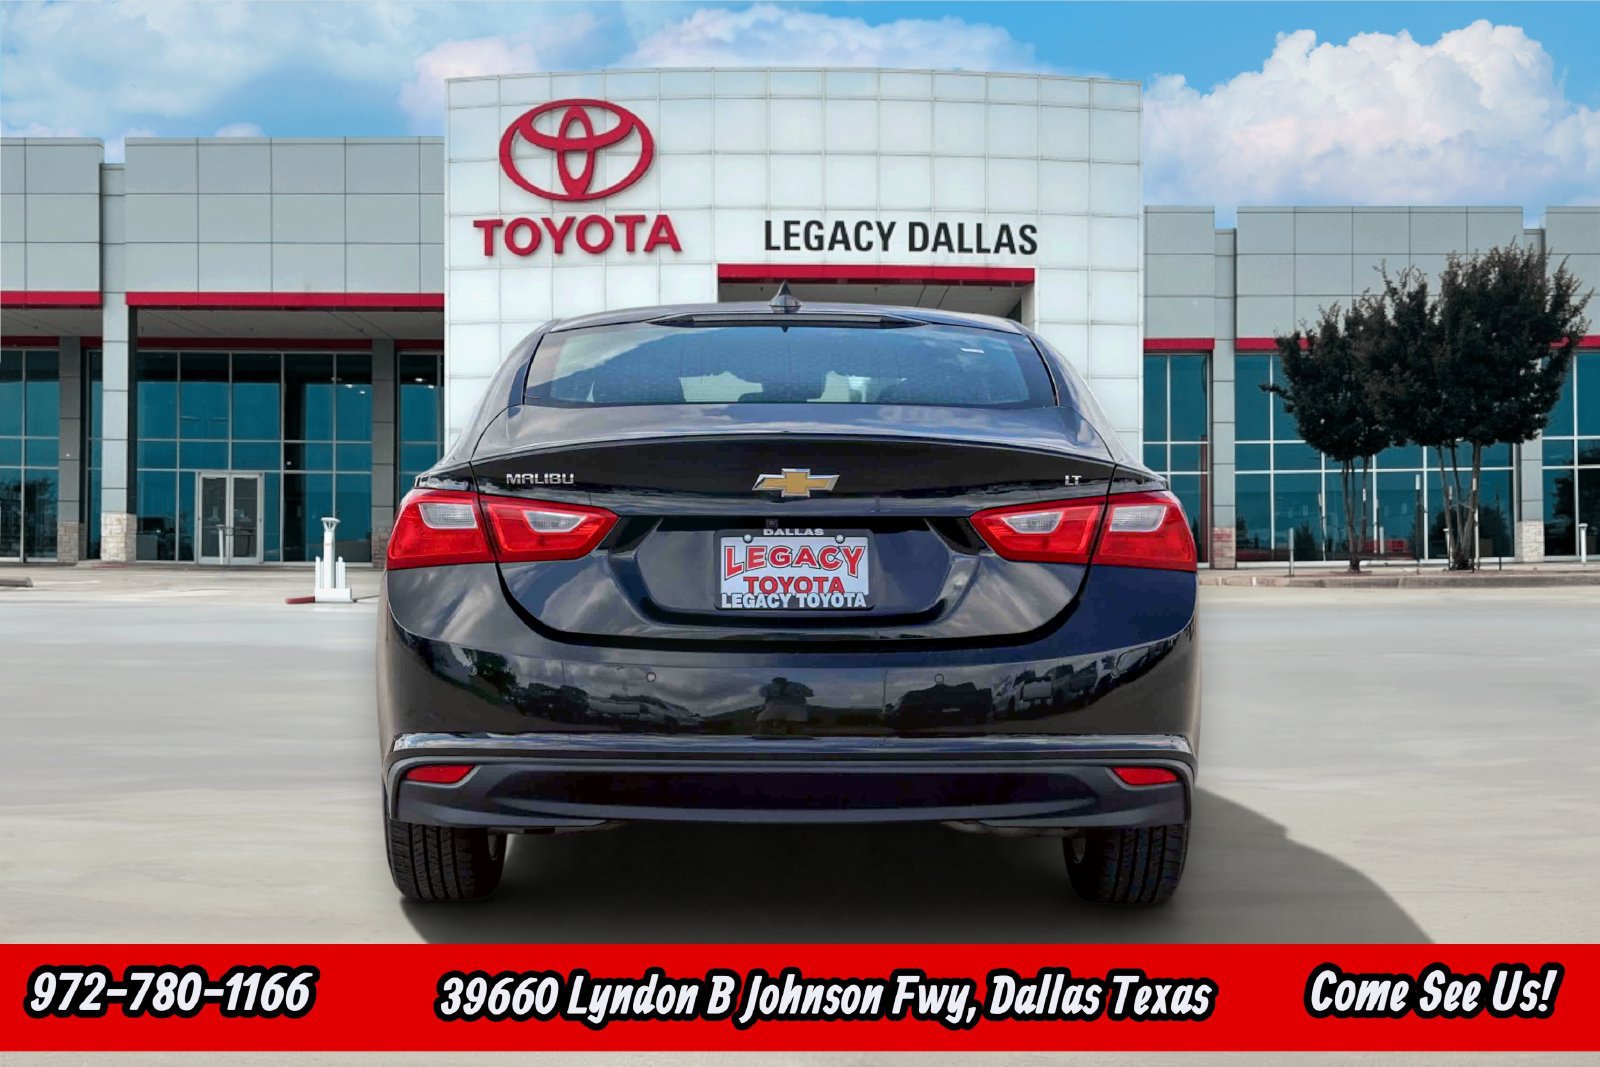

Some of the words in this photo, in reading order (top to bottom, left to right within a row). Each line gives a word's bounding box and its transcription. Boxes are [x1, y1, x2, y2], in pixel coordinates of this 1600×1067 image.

[473, 214, 682, 256] TOYOTA
[764, 220, 896, 252] LEGACY
[908, 221, 1039, 255] DALLAS
[506, 473, 574, 485] MALIBU
[1064, 475, 1082, 486] LT
[763, 528, 825, 536] DALLAS
[724, 545, 866, 580] LEGACY
[743, 576, 846, 594] TOYOTA
[721, 593, 791, 609] LEGACY
[796, 592, 867, 608] TOYOTA
